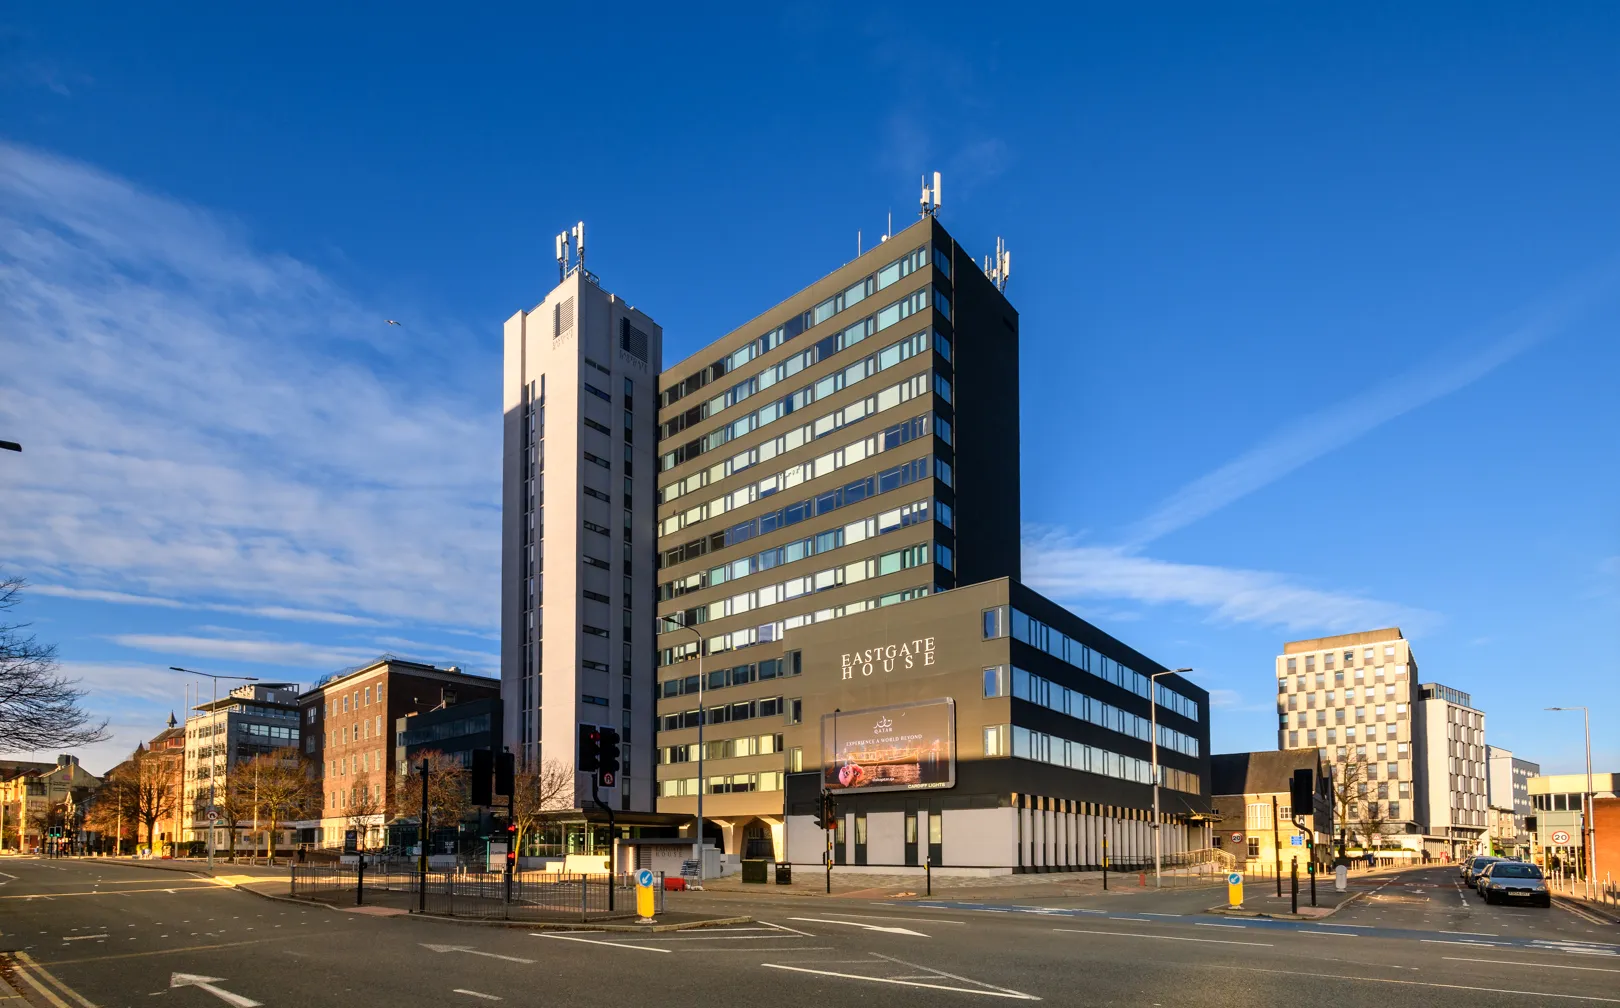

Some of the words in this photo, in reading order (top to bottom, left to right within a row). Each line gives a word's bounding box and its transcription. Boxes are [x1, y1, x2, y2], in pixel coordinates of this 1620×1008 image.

[841, 636, 936, 668] EASTGATE
[841, 651, 936, 680] HOUSE
[873, 727, 893, 735] QATAR
[846, 739, 875, 747] EXPERIENCE
